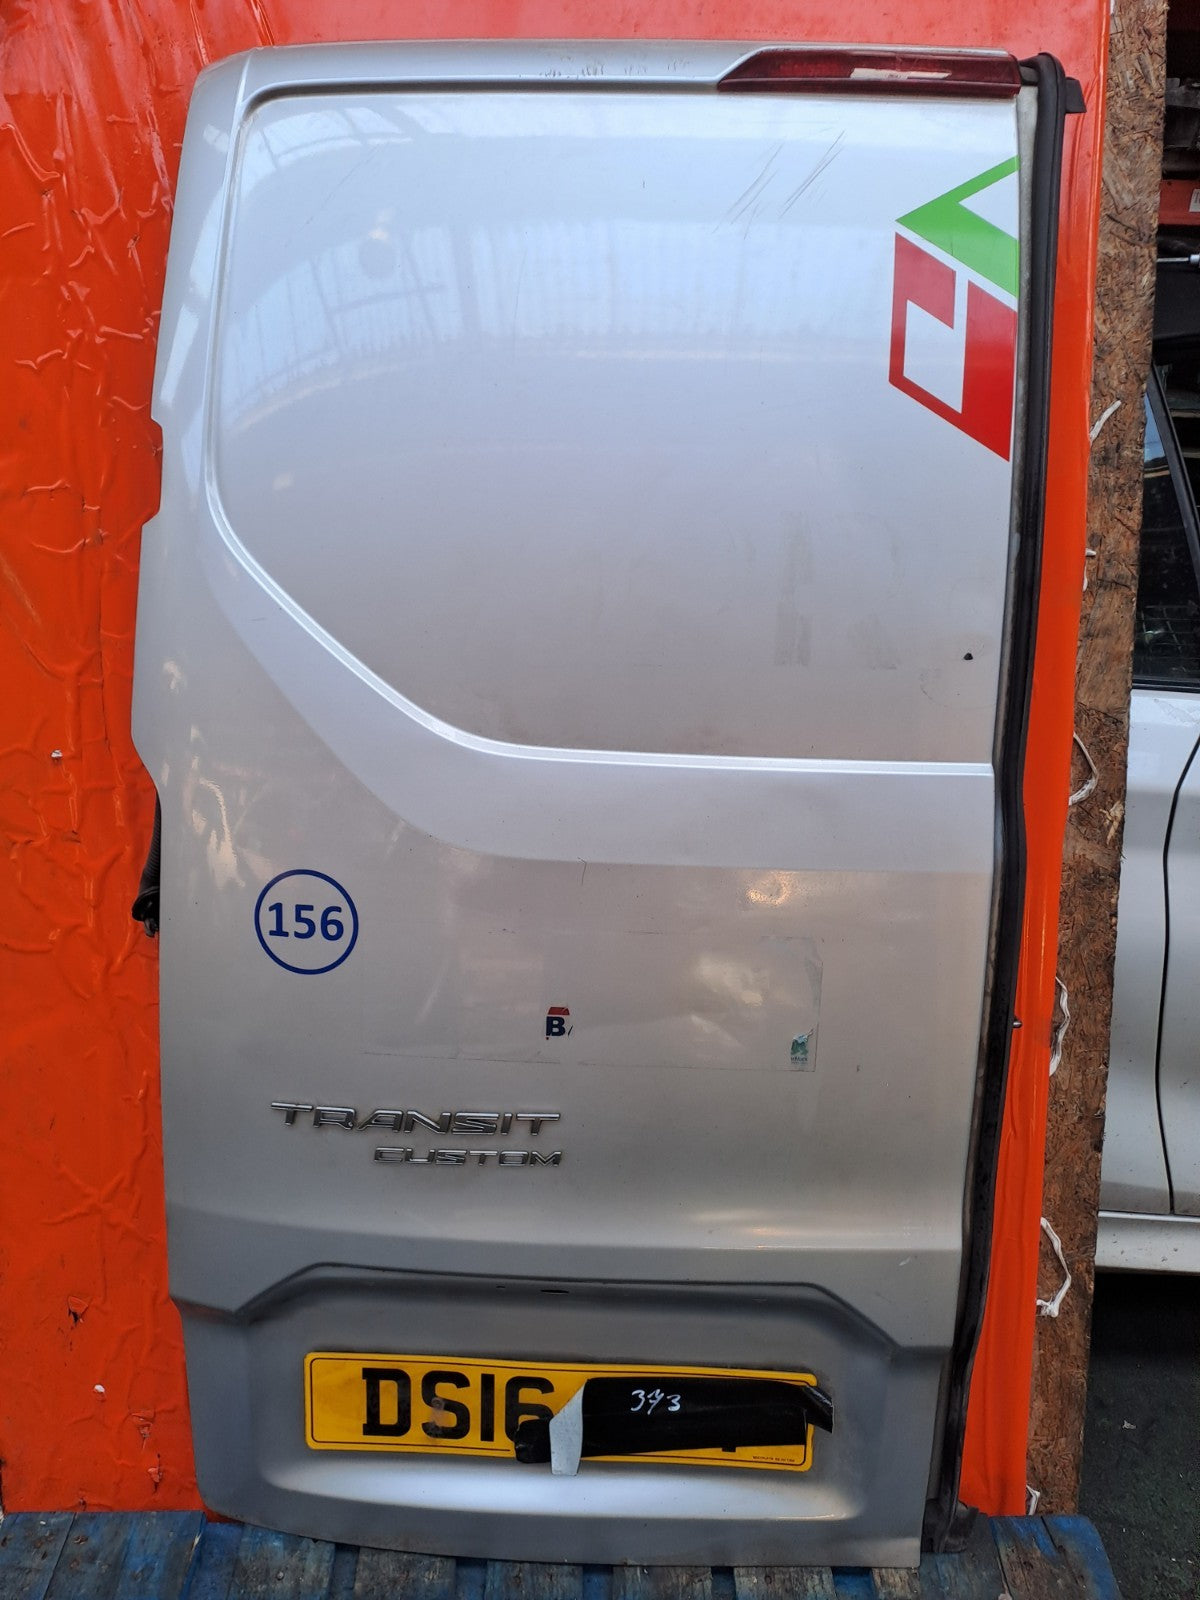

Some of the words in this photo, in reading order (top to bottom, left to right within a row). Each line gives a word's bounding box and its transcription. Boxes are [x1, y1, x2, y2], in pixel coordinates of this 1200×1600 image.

[268, 902, 344, 941] 156
[271, 1102, 560, 1136] TRANSIT
[374, 1148, 562, 1167] CUSTOM
